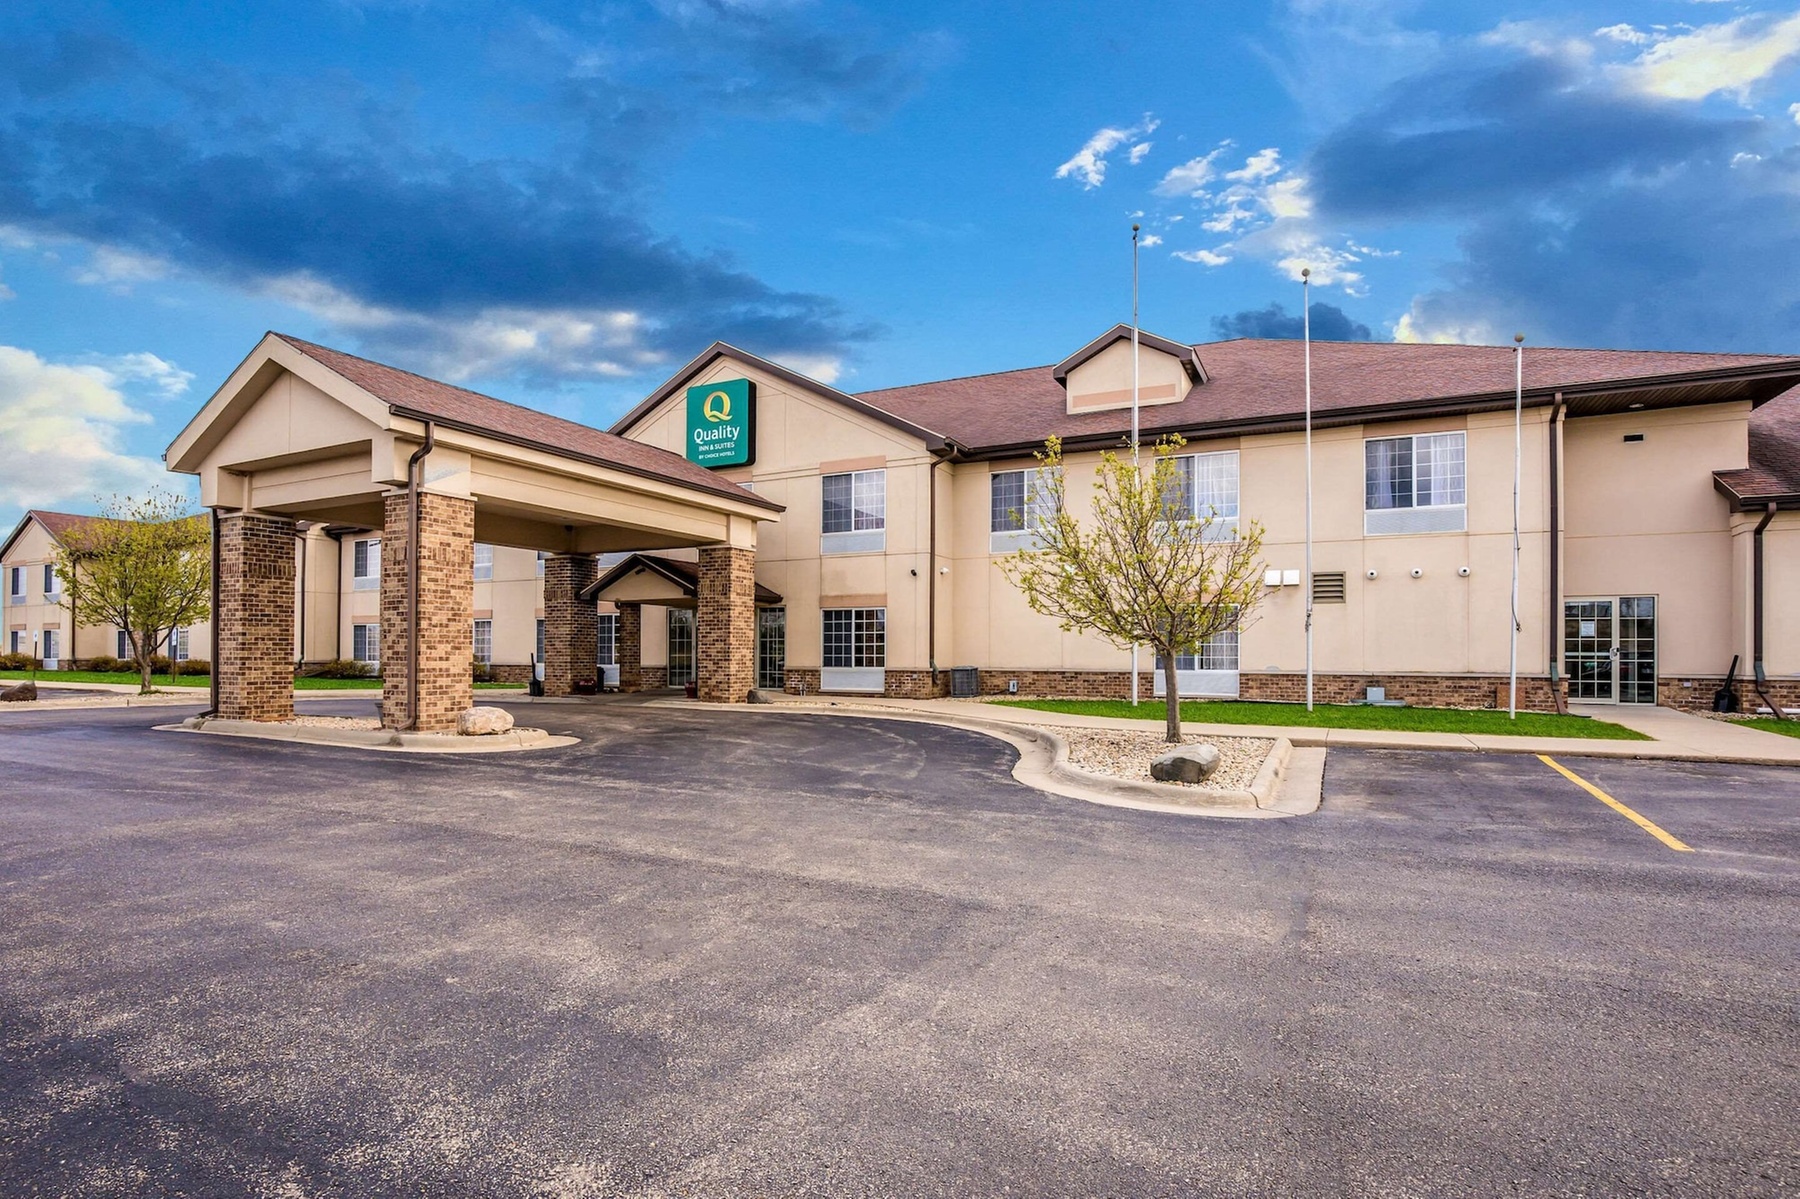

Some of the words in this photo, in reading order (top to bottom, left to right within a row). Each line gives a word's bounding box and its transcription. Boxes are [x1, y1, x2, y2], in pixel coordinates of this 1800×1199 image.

[703, 391, 733, 422] Q
[694, 425, 740, 444] Quality
[714, 442, 735, 450] SUITES
